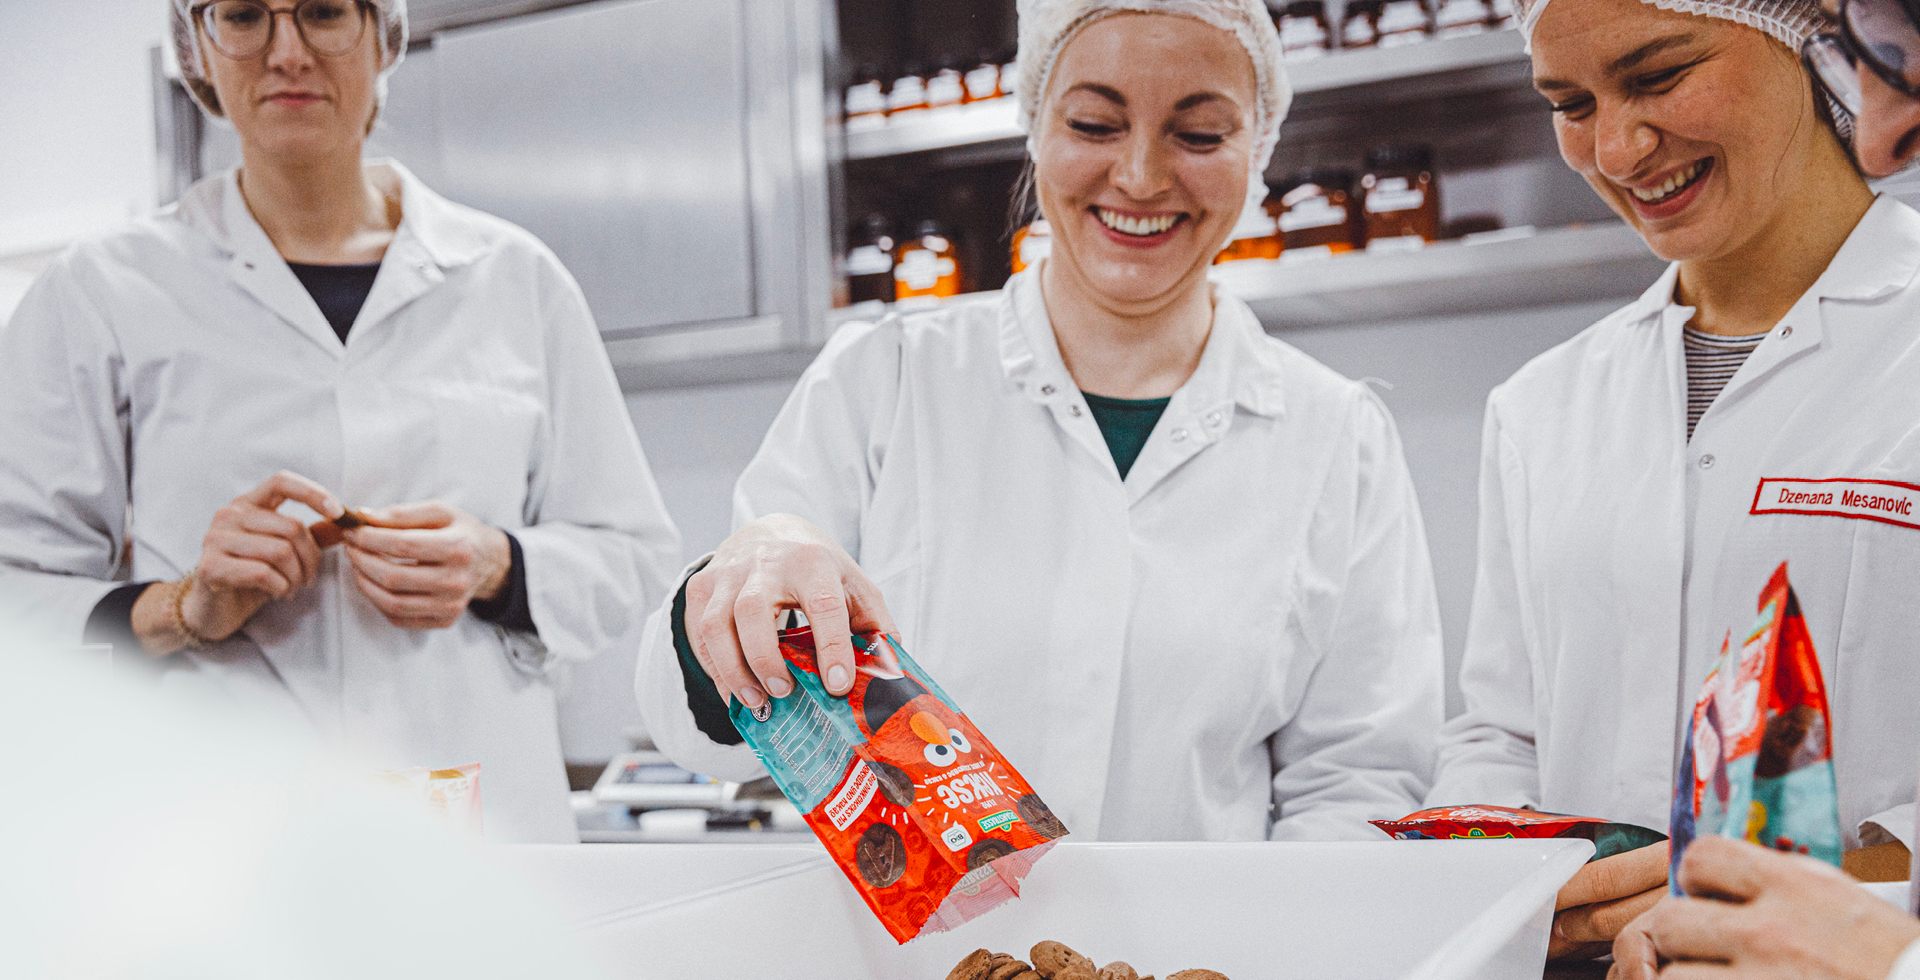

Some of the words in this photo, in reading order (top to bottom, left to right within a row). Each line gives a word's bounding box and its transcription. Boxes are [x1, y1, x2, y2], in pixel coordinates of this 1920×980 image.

[1778, 488, 1833, 505] Dzenana
[1841, 490, 1912, 516] Mesanovic
[845, 785, 857, 801] UND
